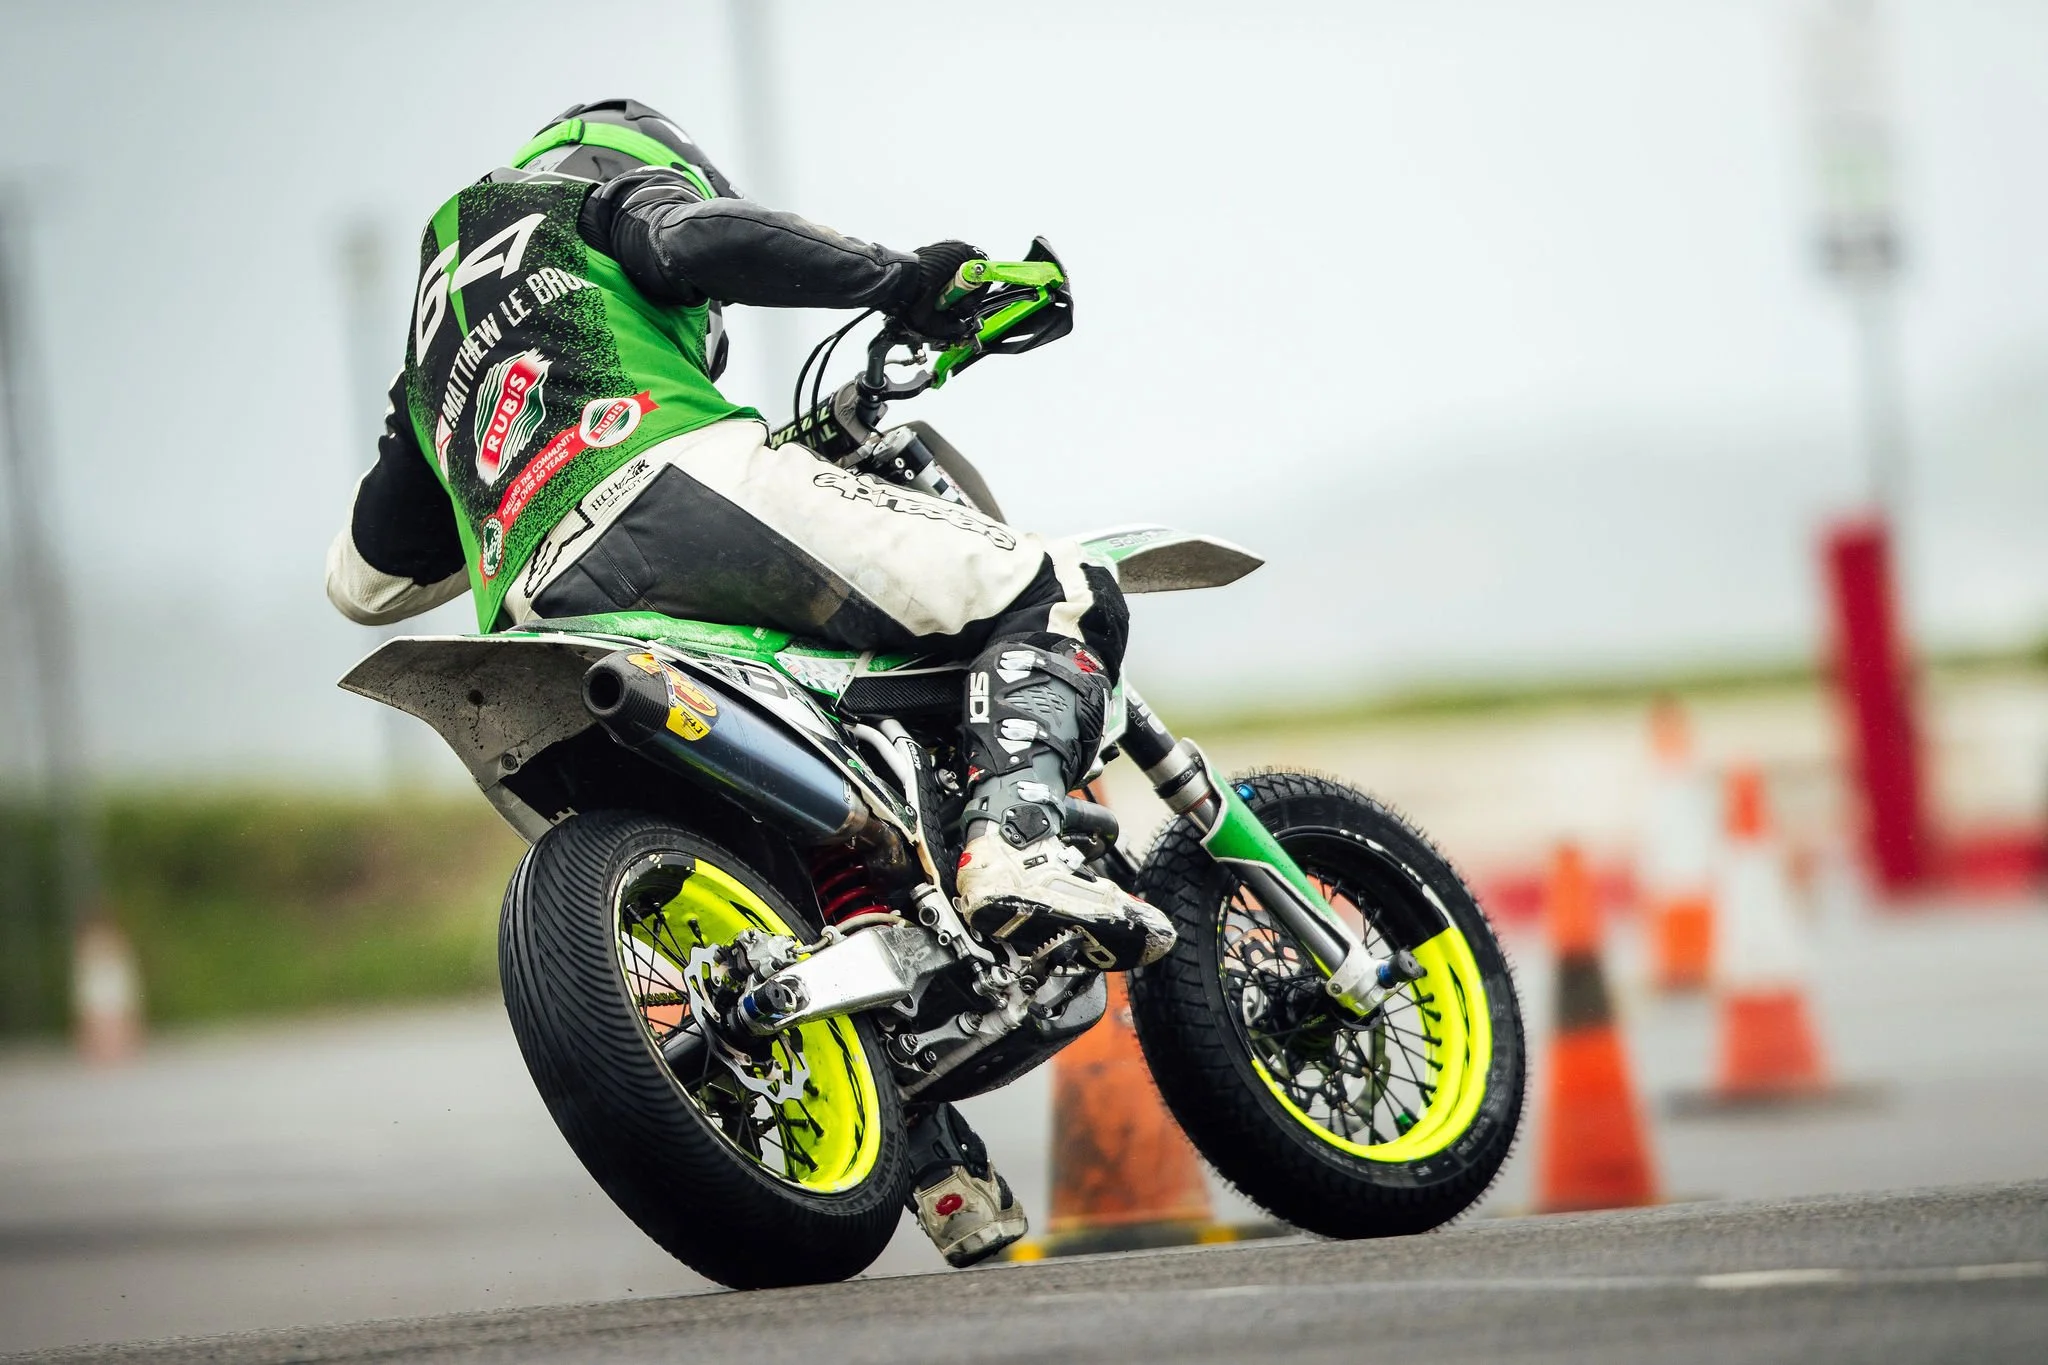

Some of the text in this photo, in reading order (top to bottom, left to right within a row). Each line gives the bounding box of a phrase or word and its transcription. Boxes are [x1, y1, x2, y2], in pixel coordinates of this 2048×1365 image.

[416, 213, 548, 367] 64
[441, 312, 502, 429] MATTHEW
[499, 287, 533, 327] LE
[502, 431, 575, 518] FUELLING THE COMMUNITY
[511, 448, 569, 516] FOR OVER 60 YEARS
[969, 671, 990, 724] SIDI
